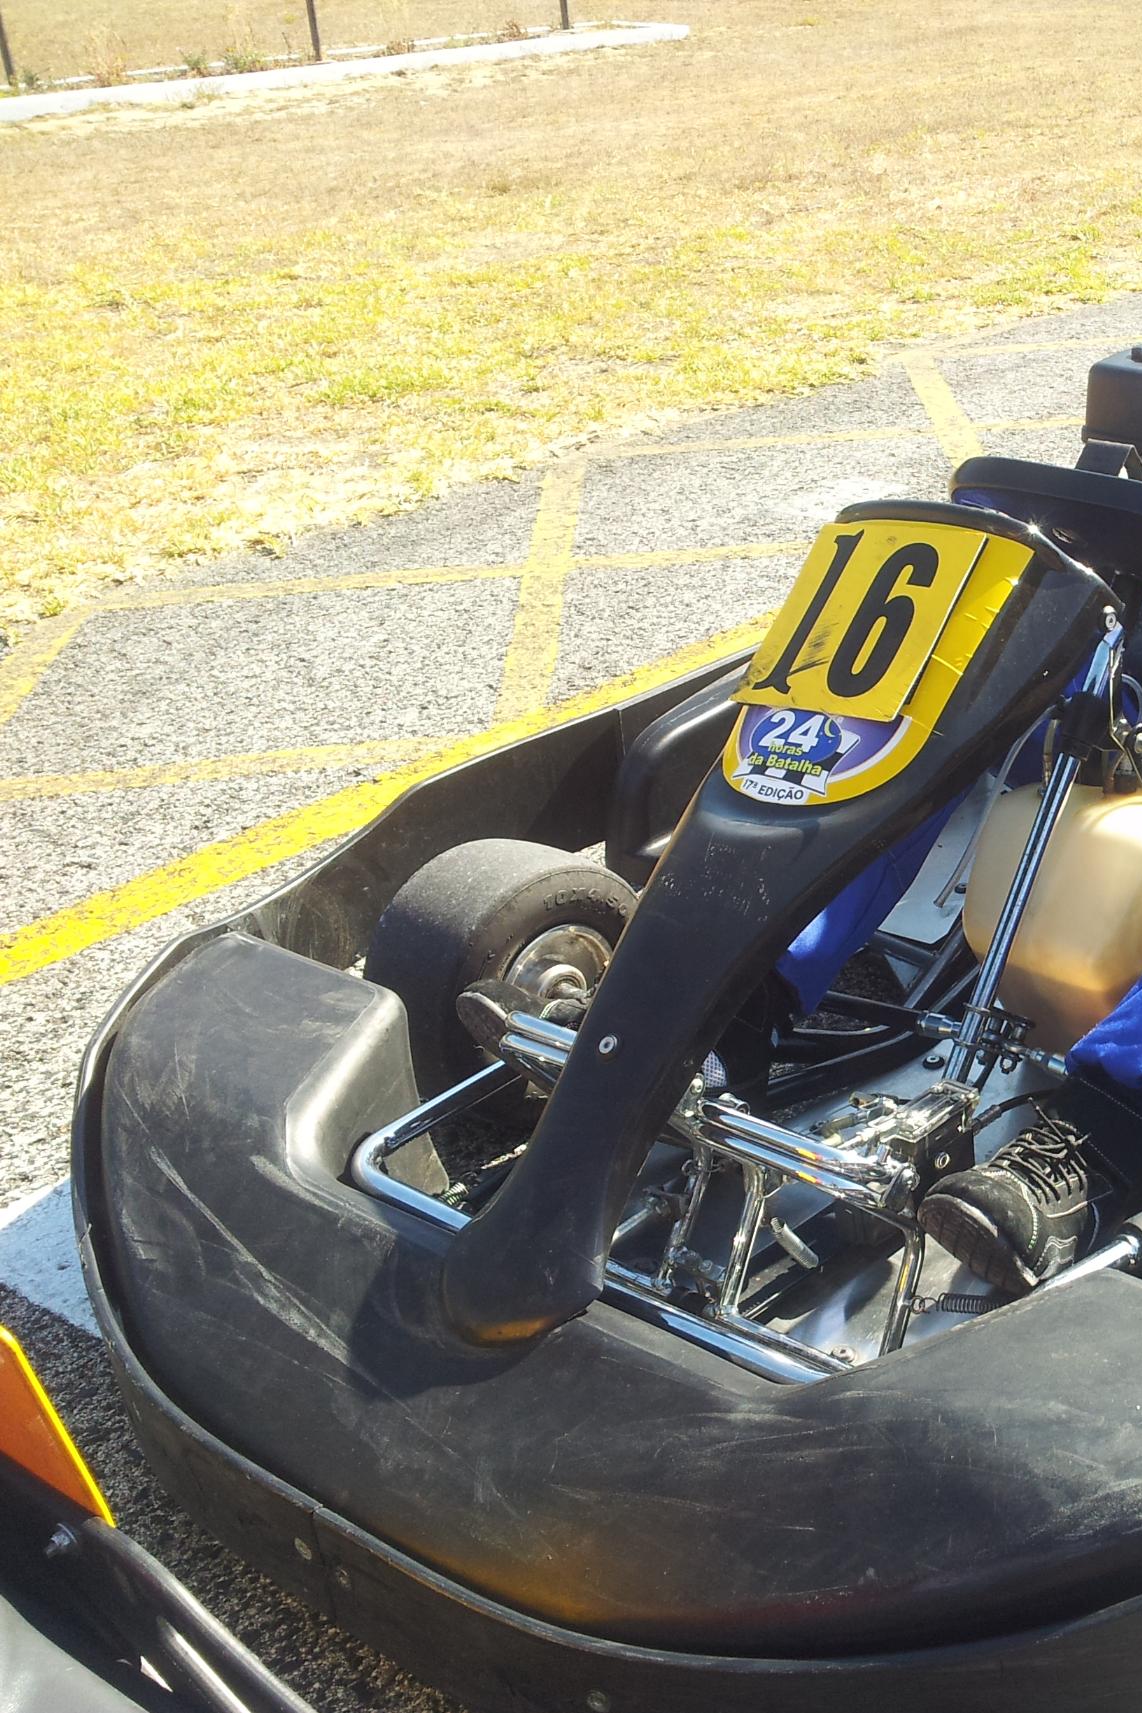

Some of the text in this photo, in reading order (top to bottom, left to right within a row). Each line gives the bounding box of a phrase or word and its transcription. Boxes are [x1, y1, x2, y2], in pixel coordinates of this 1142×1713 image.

[752, 528, 939, 698] 16
[758, 710, 825, 753] 24
[767, 740, 804, 757] horas
[748, 753, 822, 777] da Batalha
[758, 784, 805, 802] EDIÇÃO
